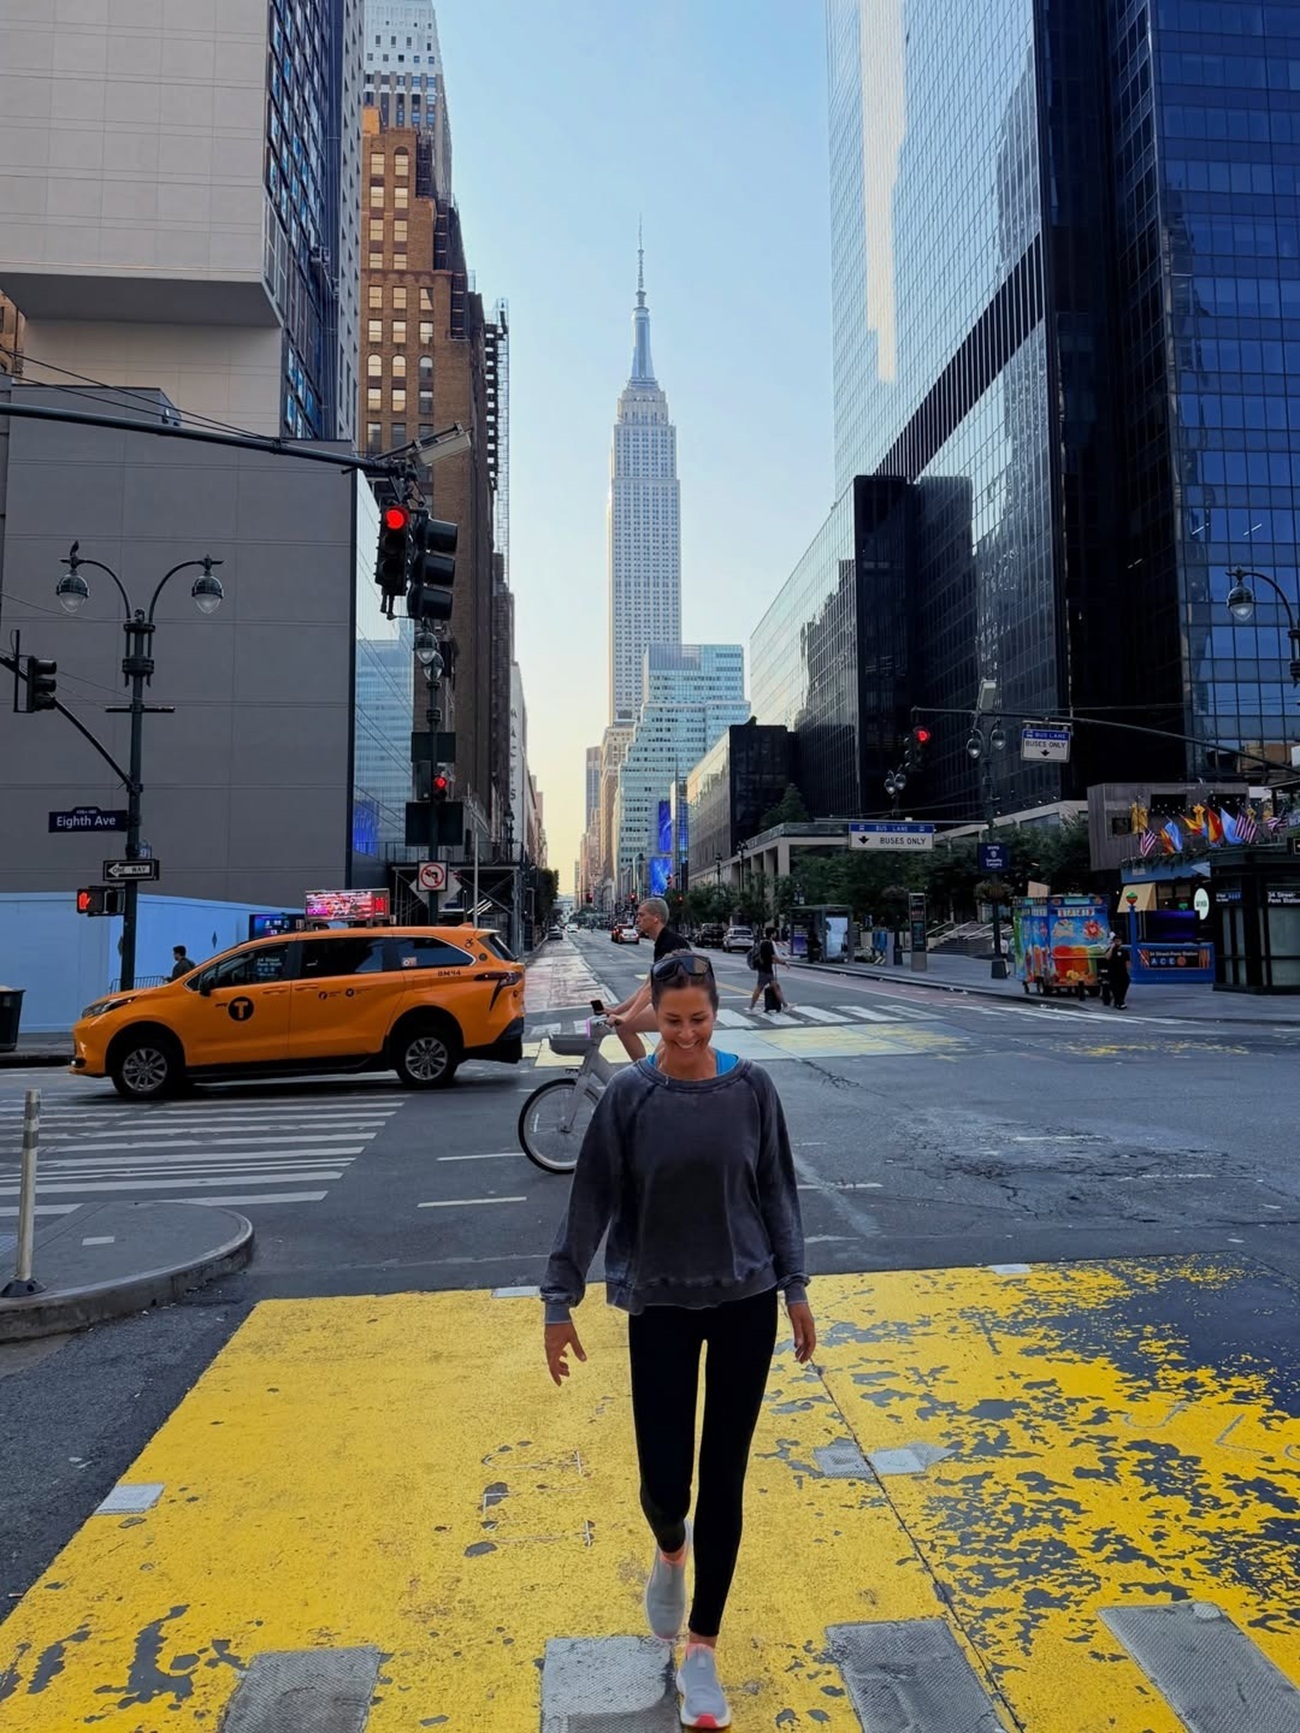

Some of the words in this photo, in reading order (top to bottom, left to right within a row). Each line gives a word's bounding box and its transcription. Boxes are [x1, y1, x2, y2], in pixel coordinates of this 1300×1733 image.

[1025, 740, 1047, 748] BUSES
[1048, 741, 1066, 749] ONLY
[56, 815, 92, 829] Eighth
[94, 815, 117, 826] Ave
[879, 836, 905, 845] BUSES
[906, 836, 927, 846] ONLY
[112, 866, 126, 874] ONE
[131, 865, 148, 873] WAY
[1151, 957, 1158, 966] A
[1168, 957, 1175, 966] E
[233, 1001, 249, 1019] T
